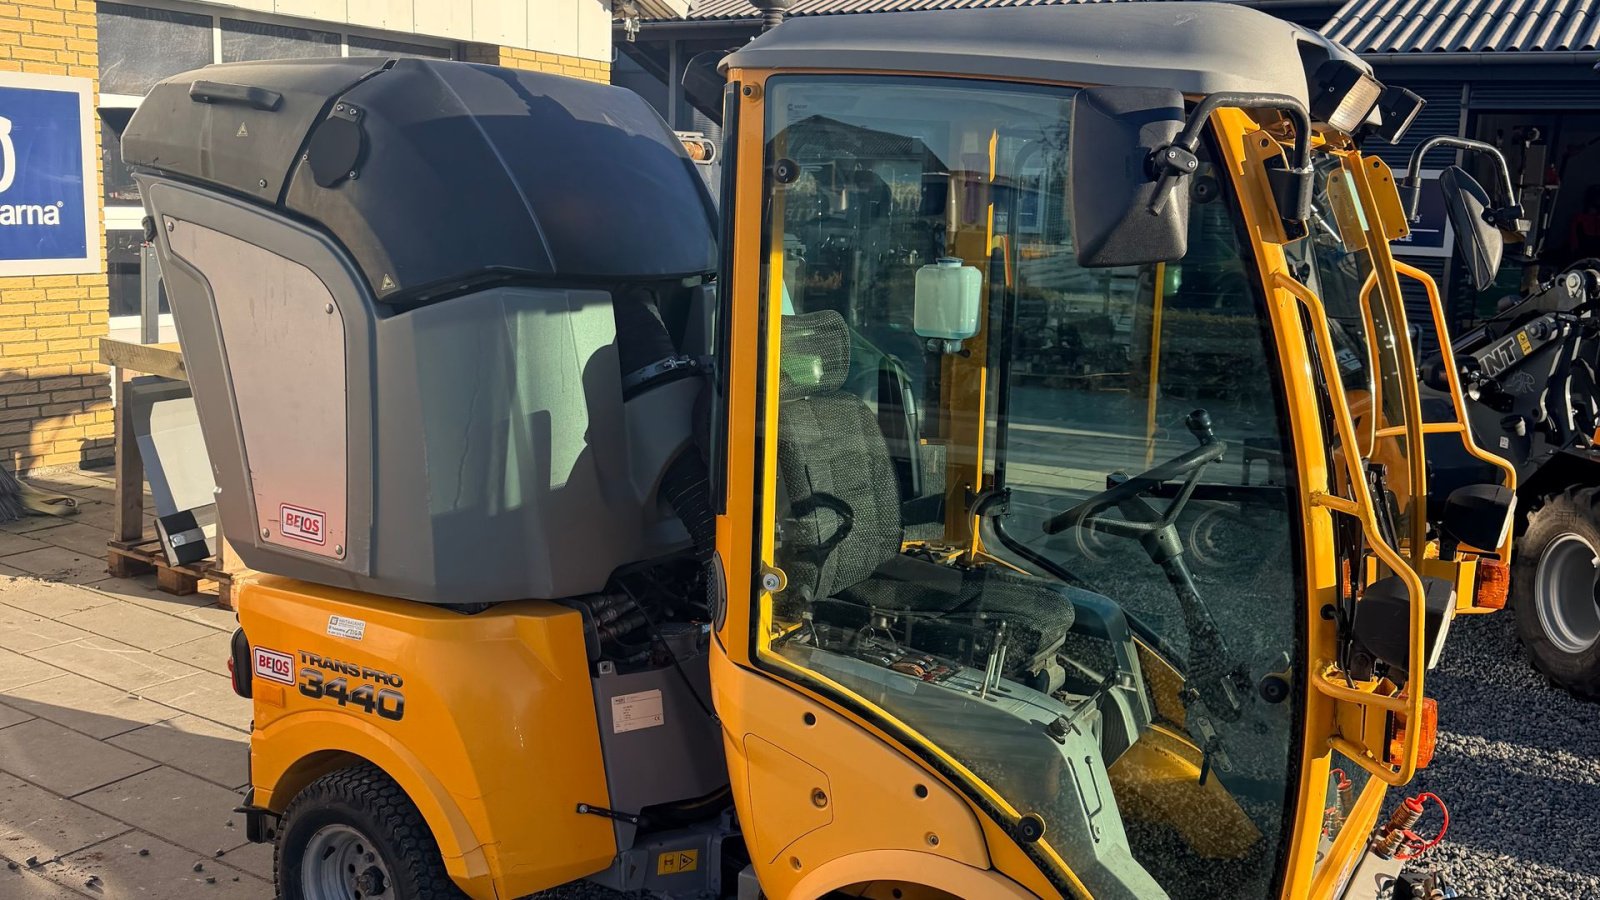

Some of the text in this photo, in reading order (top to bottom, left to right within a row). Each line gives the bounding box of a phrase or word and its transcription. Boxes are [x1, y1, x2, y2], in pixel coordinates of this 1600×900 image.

[286, 513, 320, 535] BELOS
[259, 654, 290, 677] BELOS
[298, 667, 405, 721] 3440
